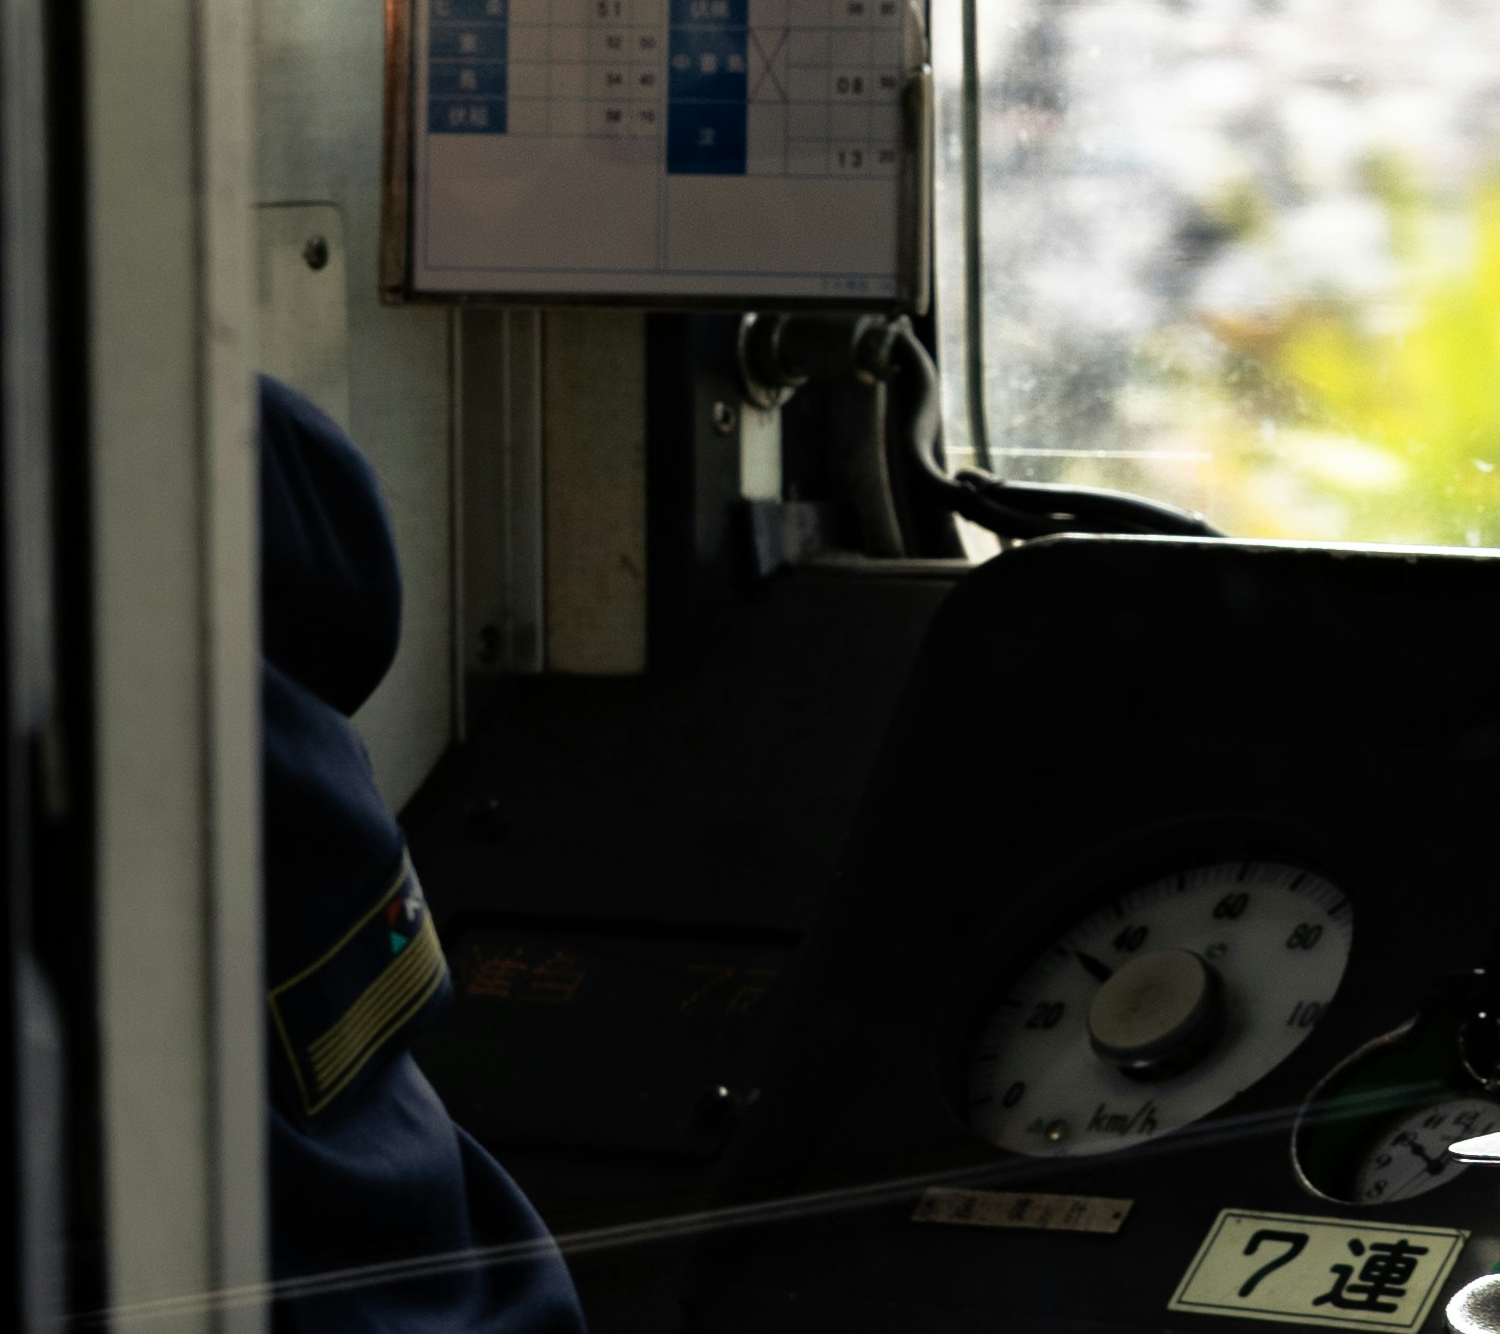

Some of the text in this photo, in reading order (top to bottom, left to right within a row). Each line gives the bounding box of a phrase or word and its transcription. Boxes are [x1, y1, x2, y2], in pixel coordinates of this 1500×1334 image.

[1212, 893, 1249, 919] 60
[1114, 926, 1148, 951] 40
[1286, 923, 1323, 950] 80
[1025, 1002, 1064, 1028] 20
[1003, 1082, 1025, 1106] 0
[1087, 1101, 1158, 1135] km/h
[1239, 1229, 1428, 1313] 7連
